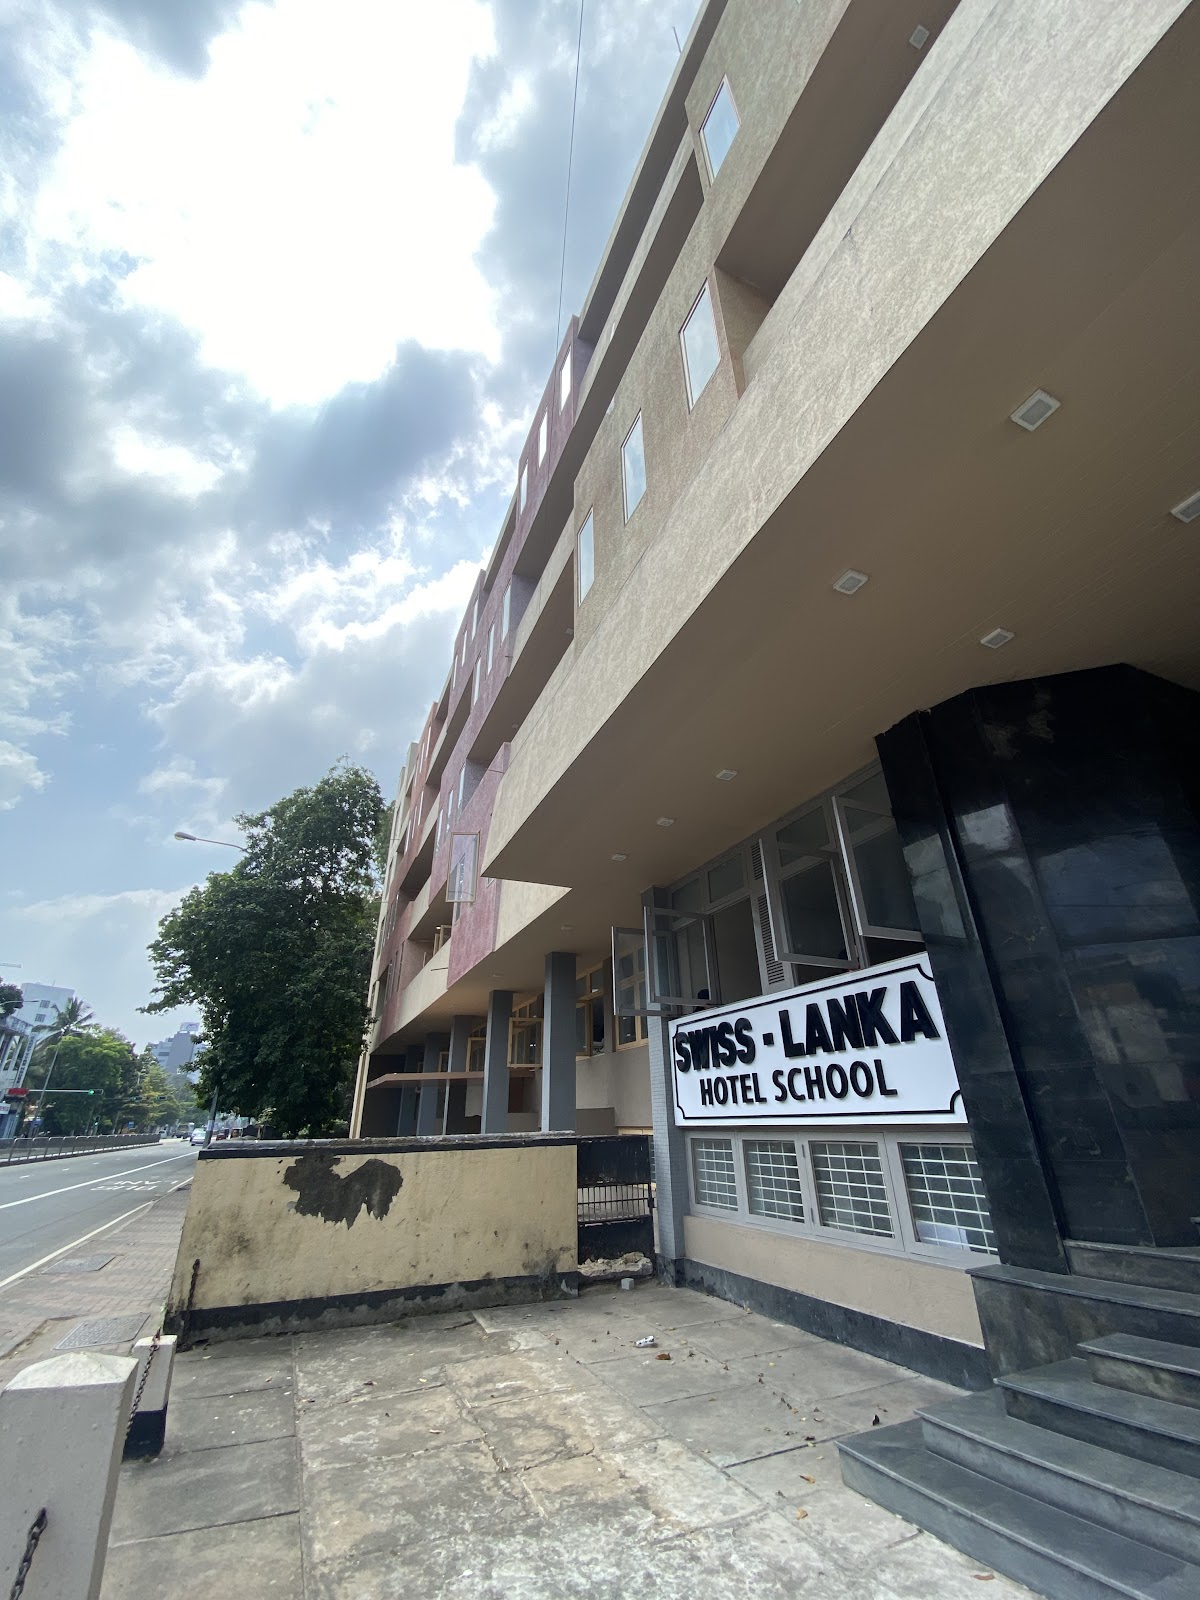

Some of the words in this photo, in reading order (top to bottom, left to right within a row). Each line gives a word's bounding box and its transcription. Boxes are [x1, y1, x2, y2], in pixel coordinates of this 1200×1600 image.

[676, 1018, 756, 1073] SWISS
[778, 980, 941, 1058] LANKA
[700, 1072, 768, 1106] HOTEL
[772, 1059, 898, 1102] SCHOOL
